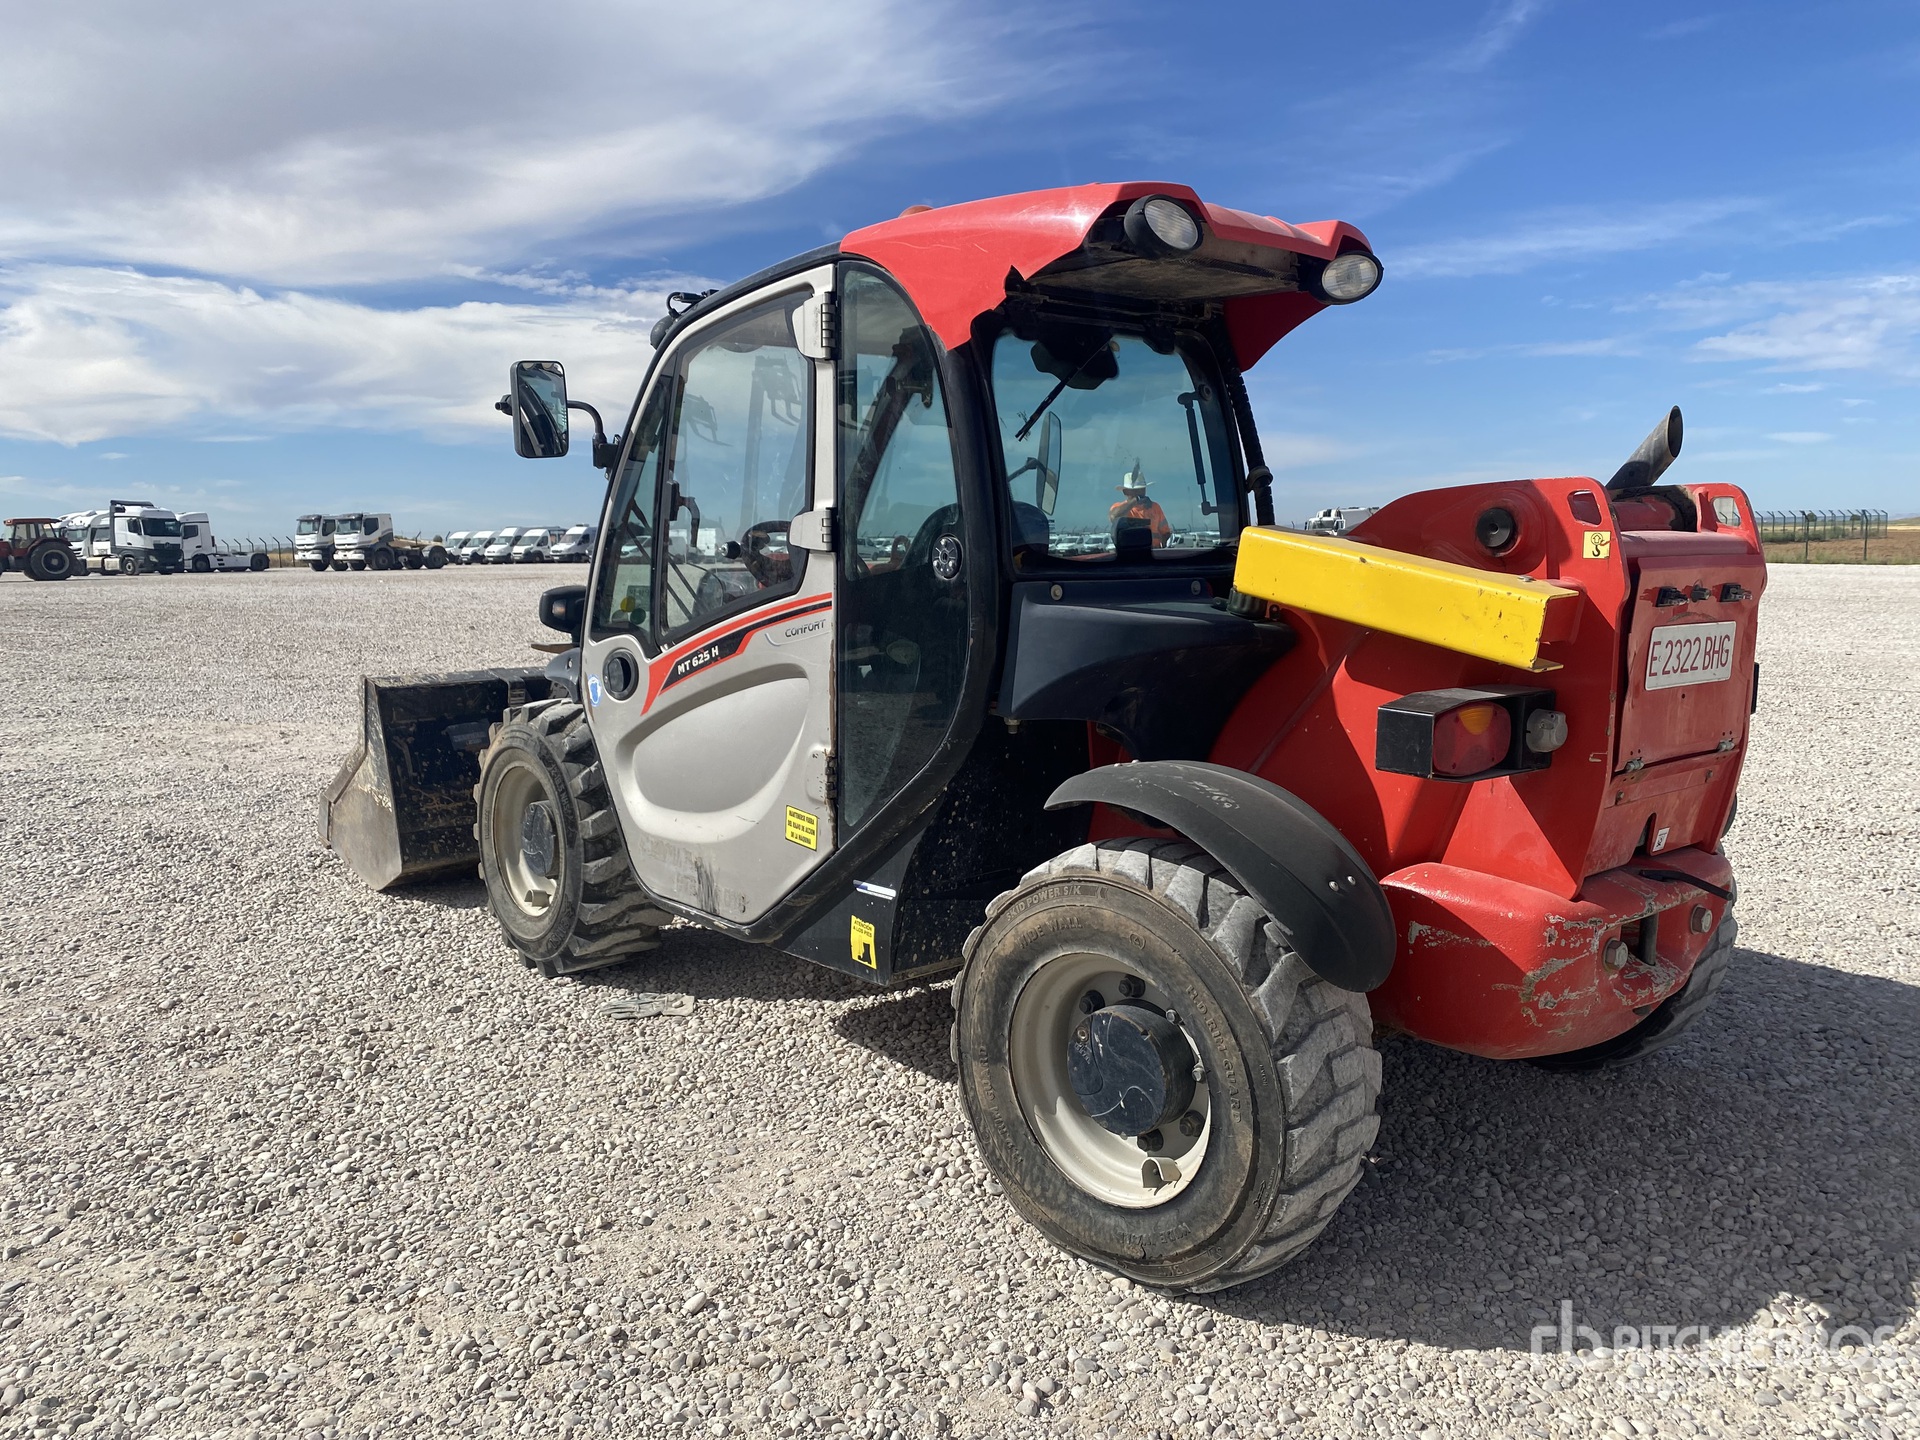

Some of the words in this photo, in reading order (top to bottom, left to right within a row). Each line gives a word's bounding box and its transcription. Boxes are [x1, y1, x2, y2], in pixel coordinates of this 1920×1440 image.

[677, 660, 691, 675] MT
[692, 650, 710, 667] 625
[711, 645, 719, 658] H
[1648, 640, 1661, 677] E
[1662, 637, 1702, 675] 2322
[1702, 634, 1731, 671] BHG
[1006, 901, 1026, 921] SKID
[1026, 886, 1061, 907] POWER
[1063, 885, 1082, 896] S/K
[1015, 925, 1045, 949] WIDE
[1223, 1058, 1243, 1124] GUARD
